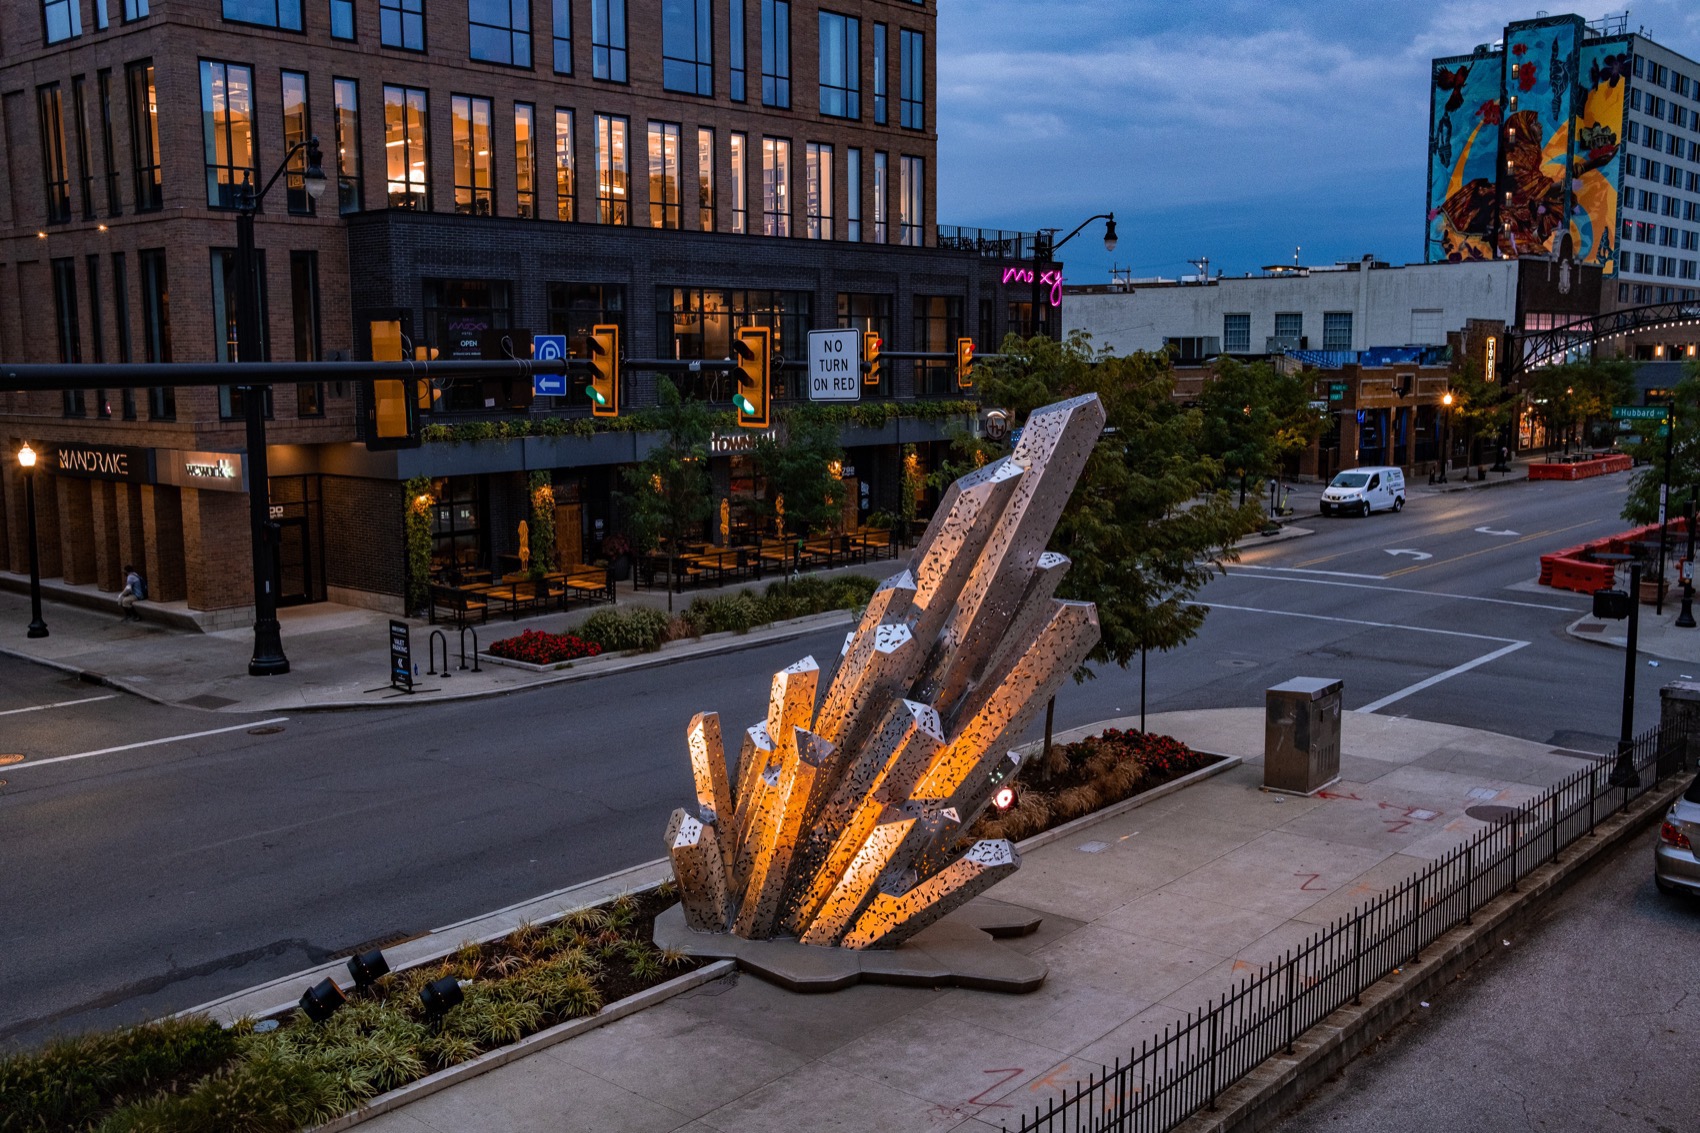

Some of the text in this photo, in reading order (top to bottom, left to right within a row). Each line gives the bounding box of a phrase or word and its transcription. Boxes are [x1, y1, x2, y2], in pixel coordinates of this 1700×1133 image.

[1002, 267, 1063, 307] moxy
[824, 339, 843, 353] NO
[819, 358, 848, 372] TURN
[814, 377, 855, 391] ON RED
[1621, 408, 1655, 417] Hubbard
[58, 448, 129, 475] MANDRAKE
